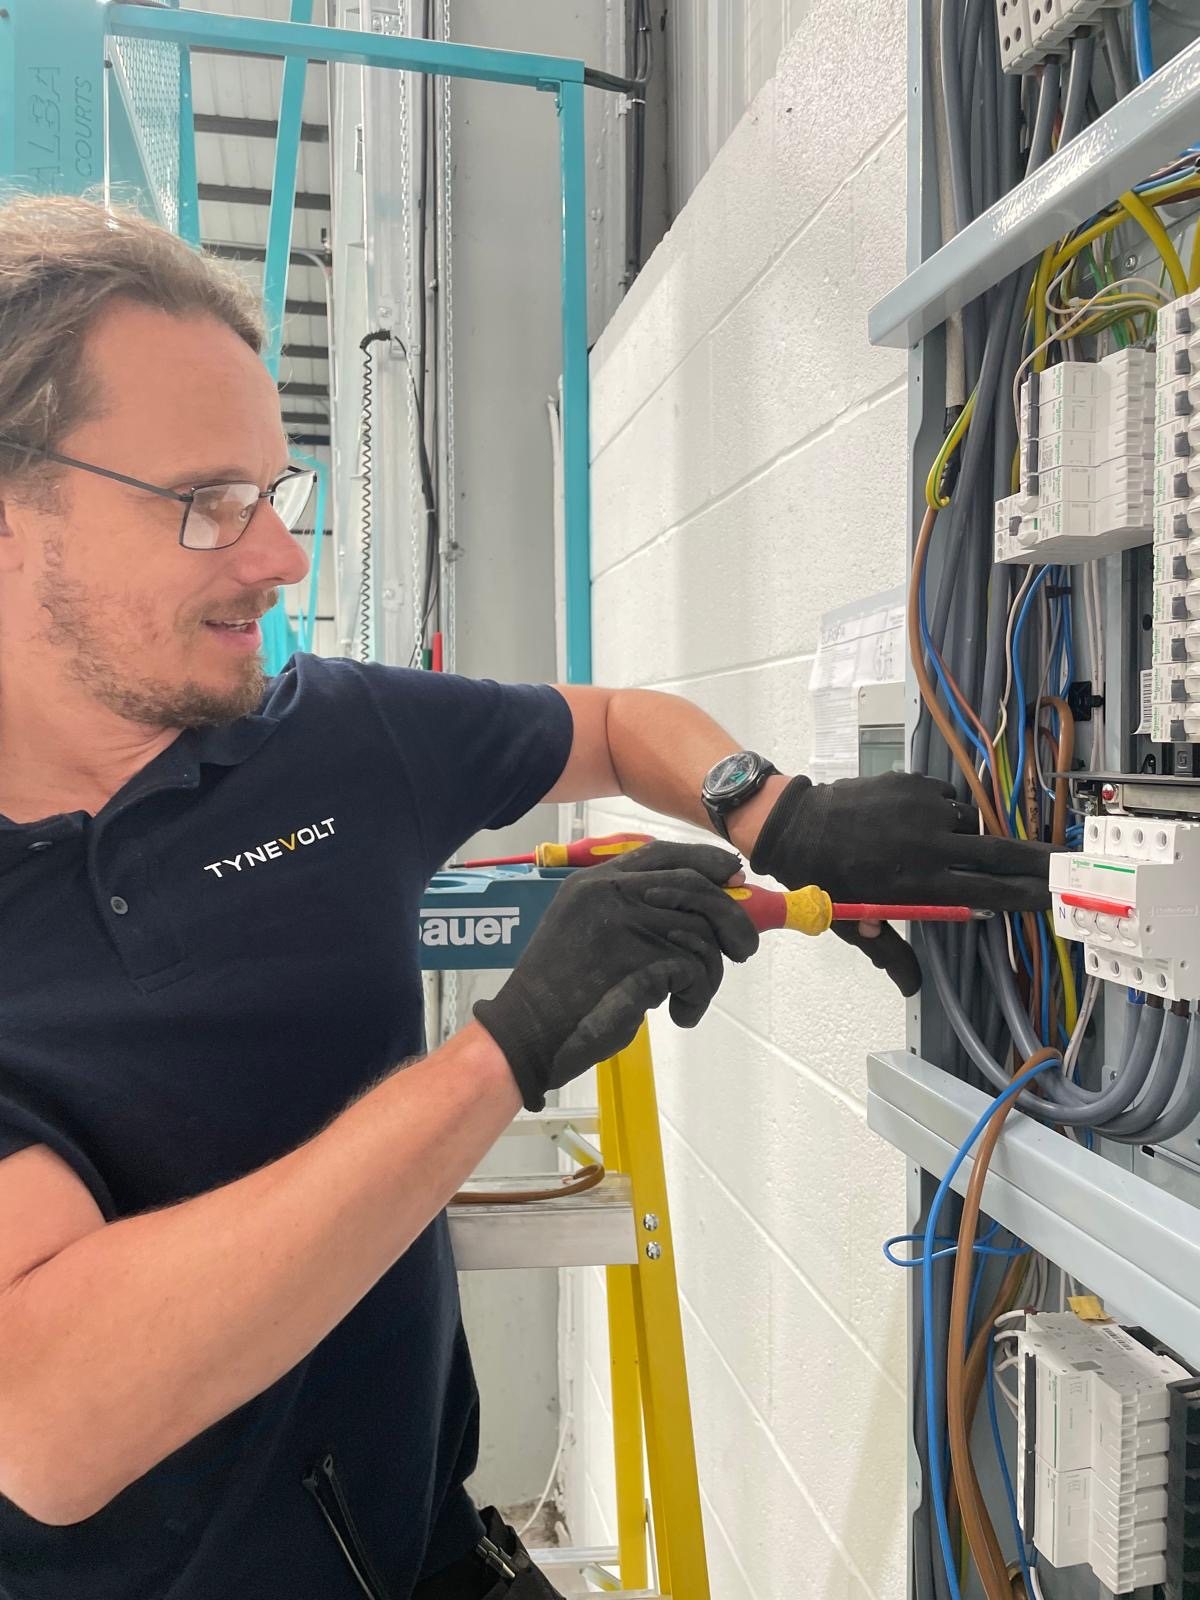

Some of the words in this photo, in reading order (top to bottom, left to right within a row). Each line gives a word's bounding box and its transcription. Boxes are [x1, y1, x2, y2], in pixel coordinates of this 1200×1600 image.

[75, 75, 92, 177] COURTS
[204, 817, 335, 878] TYNEVOLT
[419, 917, 520, 946] auer
